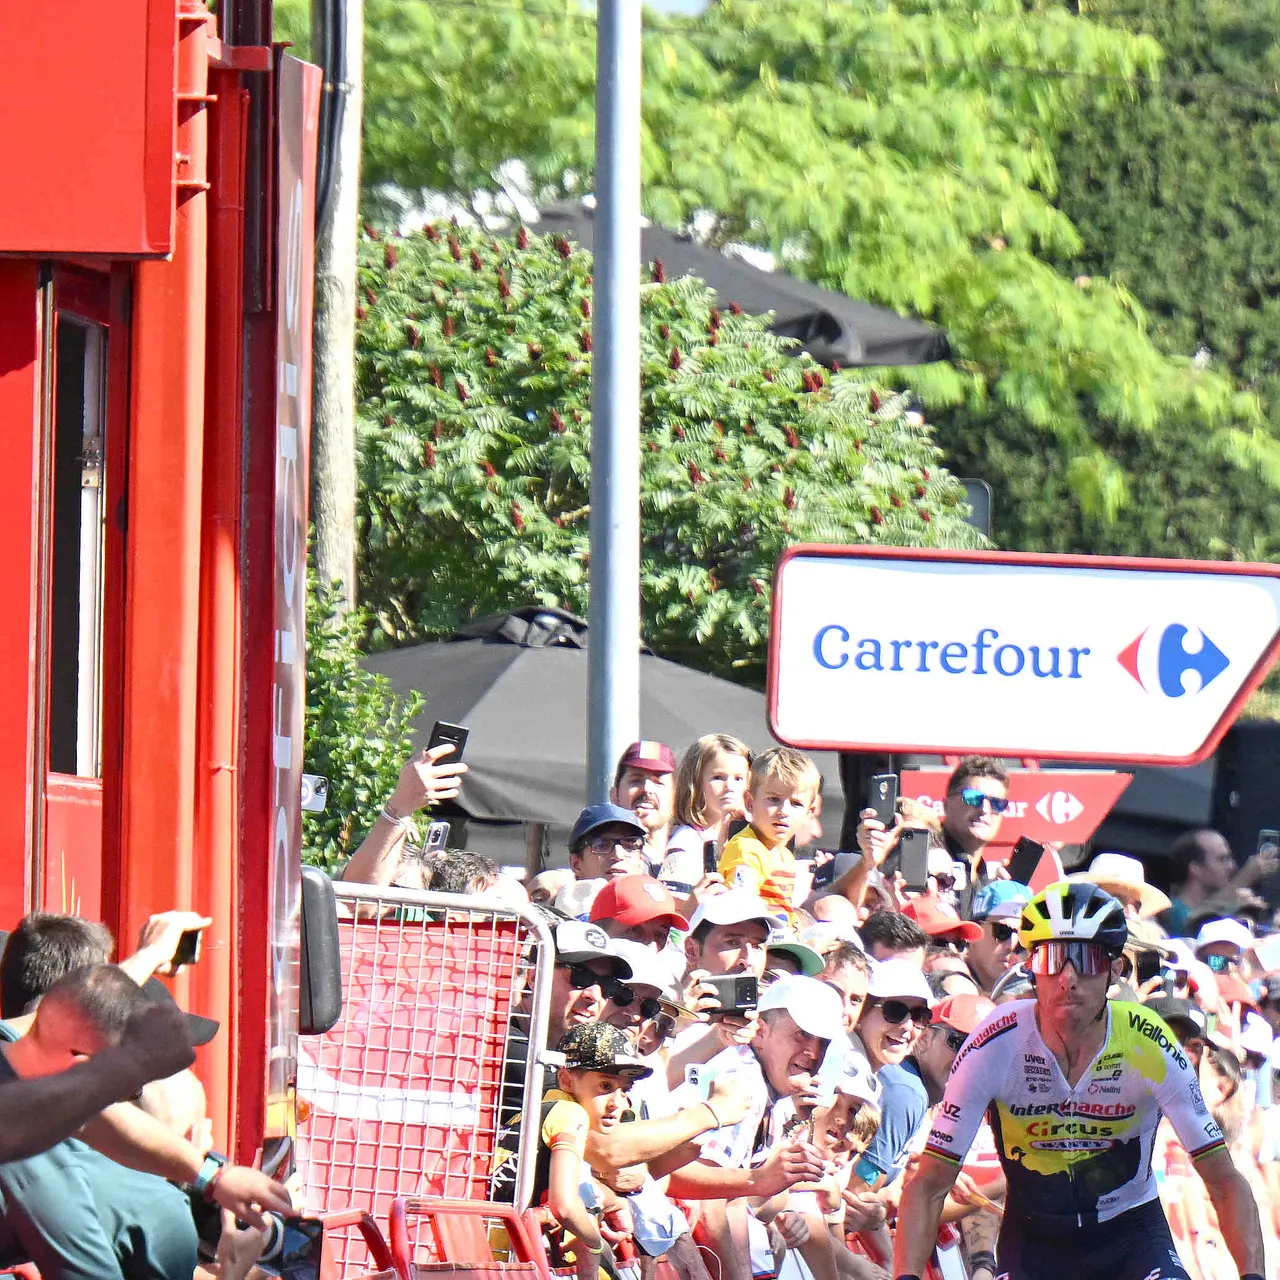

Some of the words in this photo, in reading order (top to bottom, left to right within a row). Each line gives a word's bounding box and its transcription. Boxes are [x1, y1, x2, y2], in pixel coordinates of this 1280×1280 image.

[811, 624, 1091, 680] Carrefour
[1128, 1010, 1188, 1071] Wallonie
[1025, 1120, 1114, 1137] Circus
